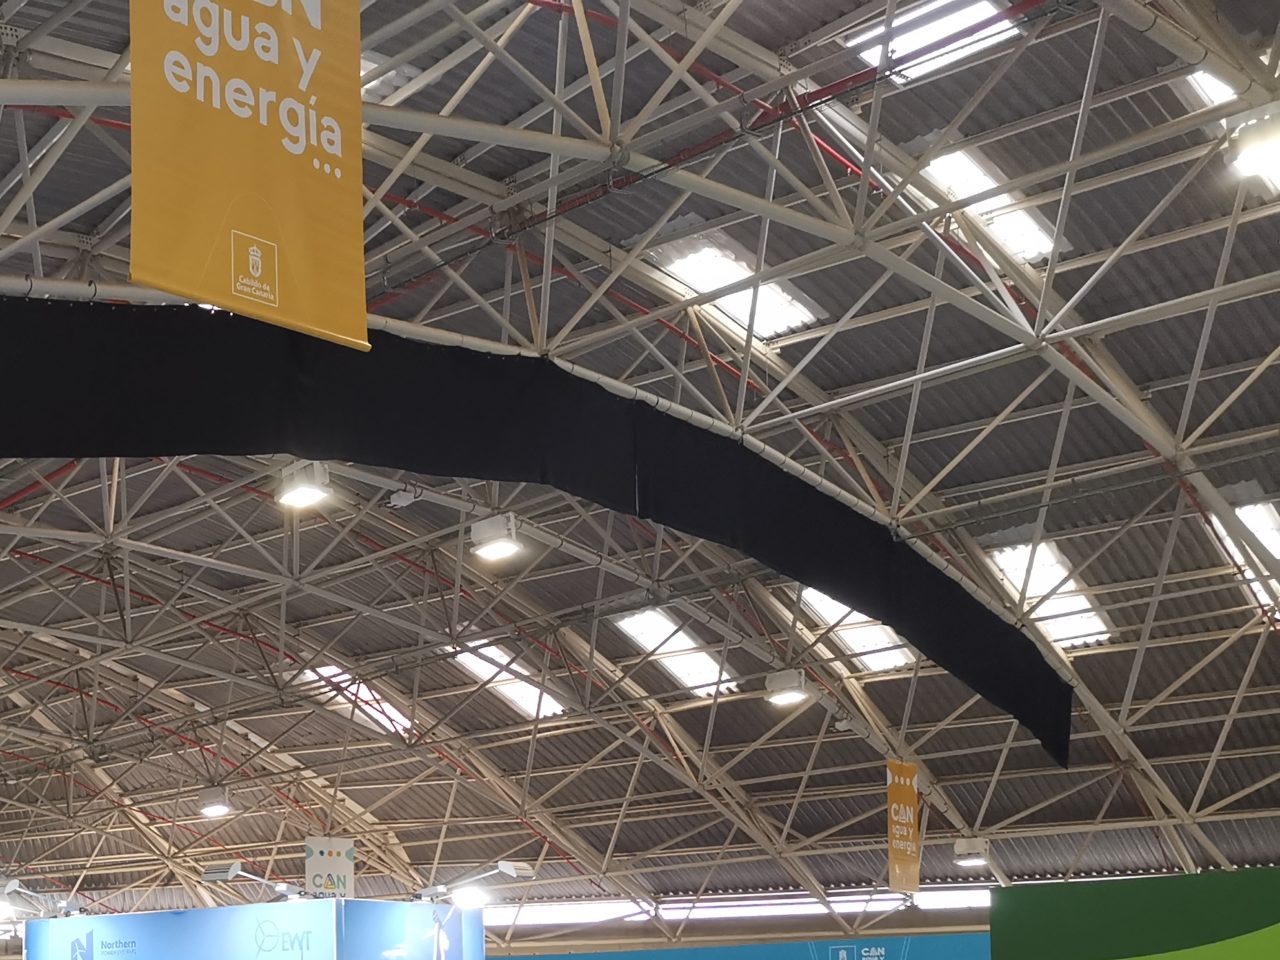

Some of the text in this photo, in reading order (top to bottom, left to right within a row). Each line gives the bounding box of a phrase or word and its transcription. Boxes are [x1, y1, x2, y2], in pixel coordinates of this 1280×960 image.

[163, 0, 279, 64] agua
[293, 38, 322, 92] y
[163, 50, 342, 156] energía
[312, 873, 347, 890] CAN
[101, 940, 136, 950] Northern
[861, 947, 885, 956] CAN
